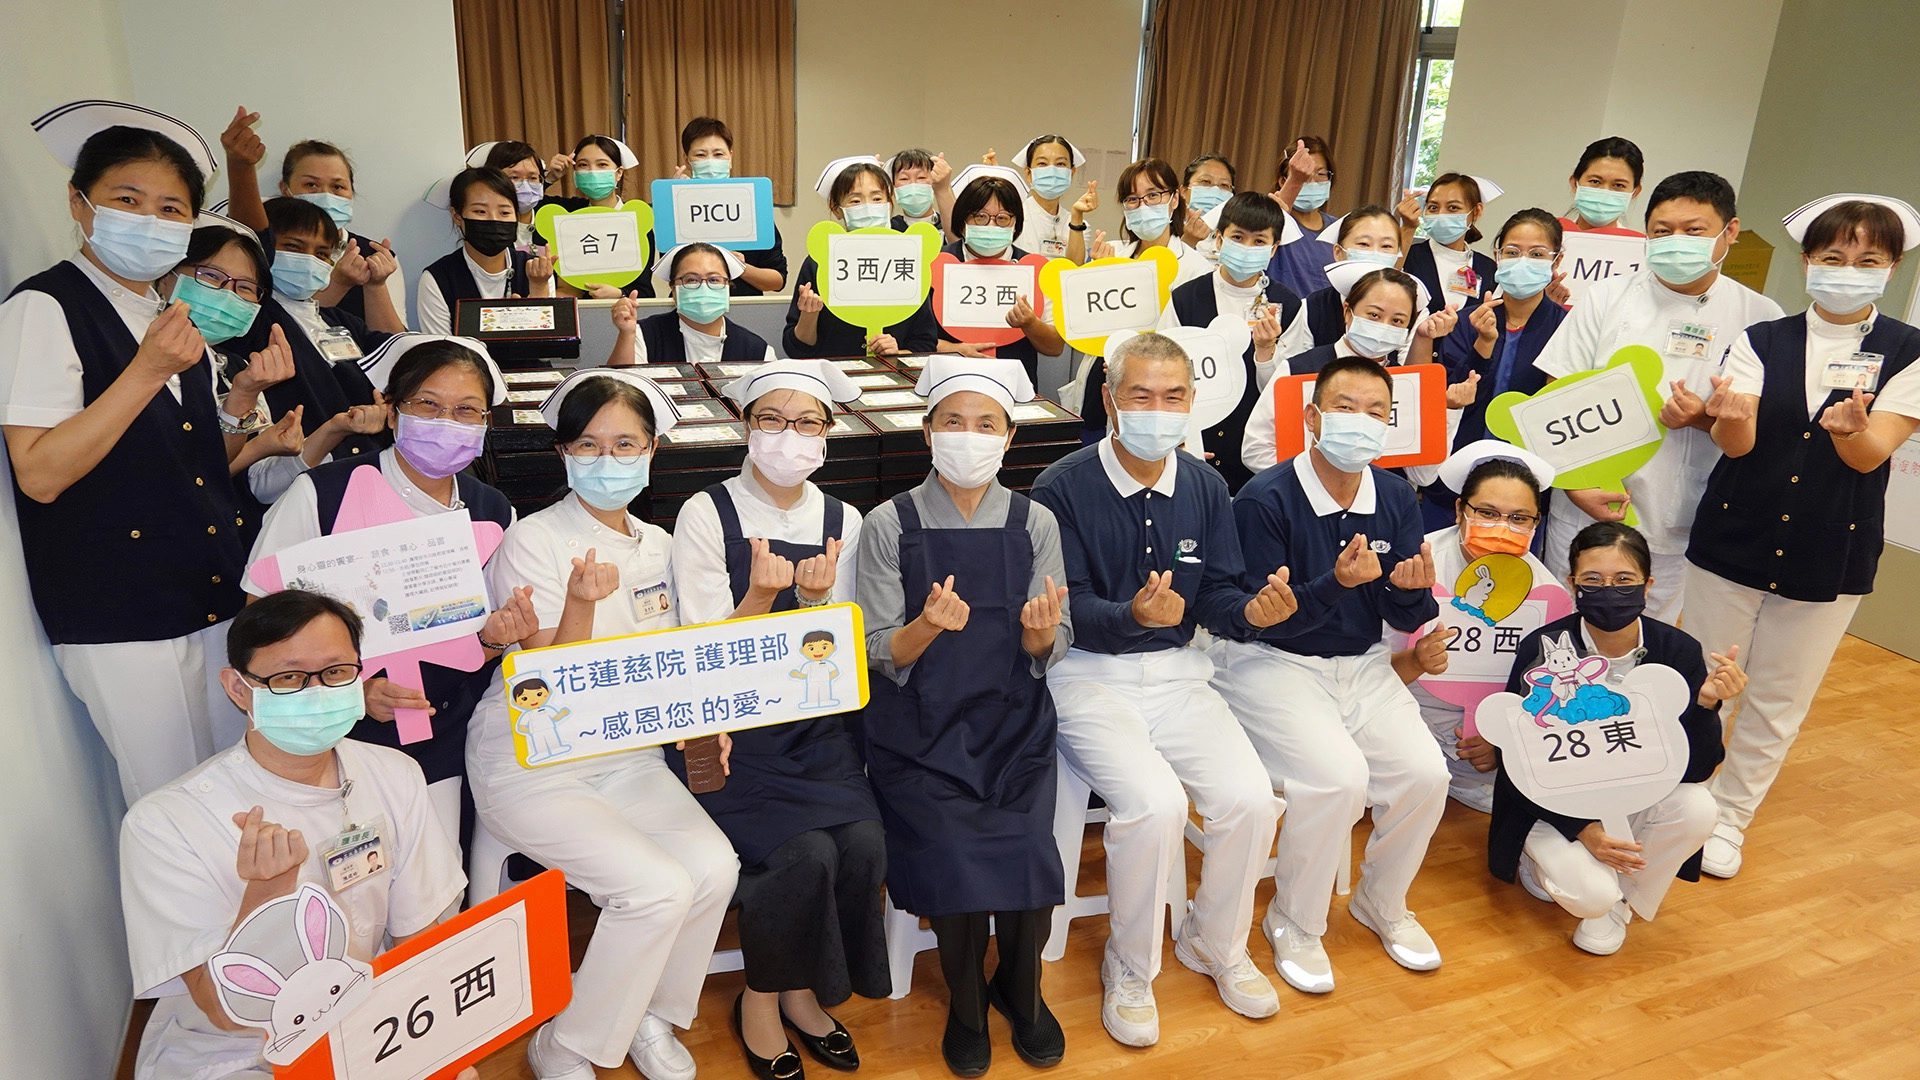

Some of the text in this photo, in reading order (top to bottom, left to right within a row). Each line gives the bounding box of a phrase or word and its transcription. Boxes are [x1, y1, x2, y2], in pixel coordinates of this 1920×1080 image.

[690, 203, 741, 223] PICU
[579, 233, 618, 255] 合 7
[836, 257, 916, 284] 3 西/東
[959, 285, 1018, 307] 23 西
[1087, 287, 1137, 313] RCC
[1544, 398, 1624, 447] SICU
[1445, 625, 1523, 655] 28 西
[552, 632, 791, 695] 花蓮慈院 護理部
[578, 688, 783, 742] ~感恩您 的愛~
[1543, 720, 1642, 763] 28 東
[373, 956, 496, 1064] 26 西
